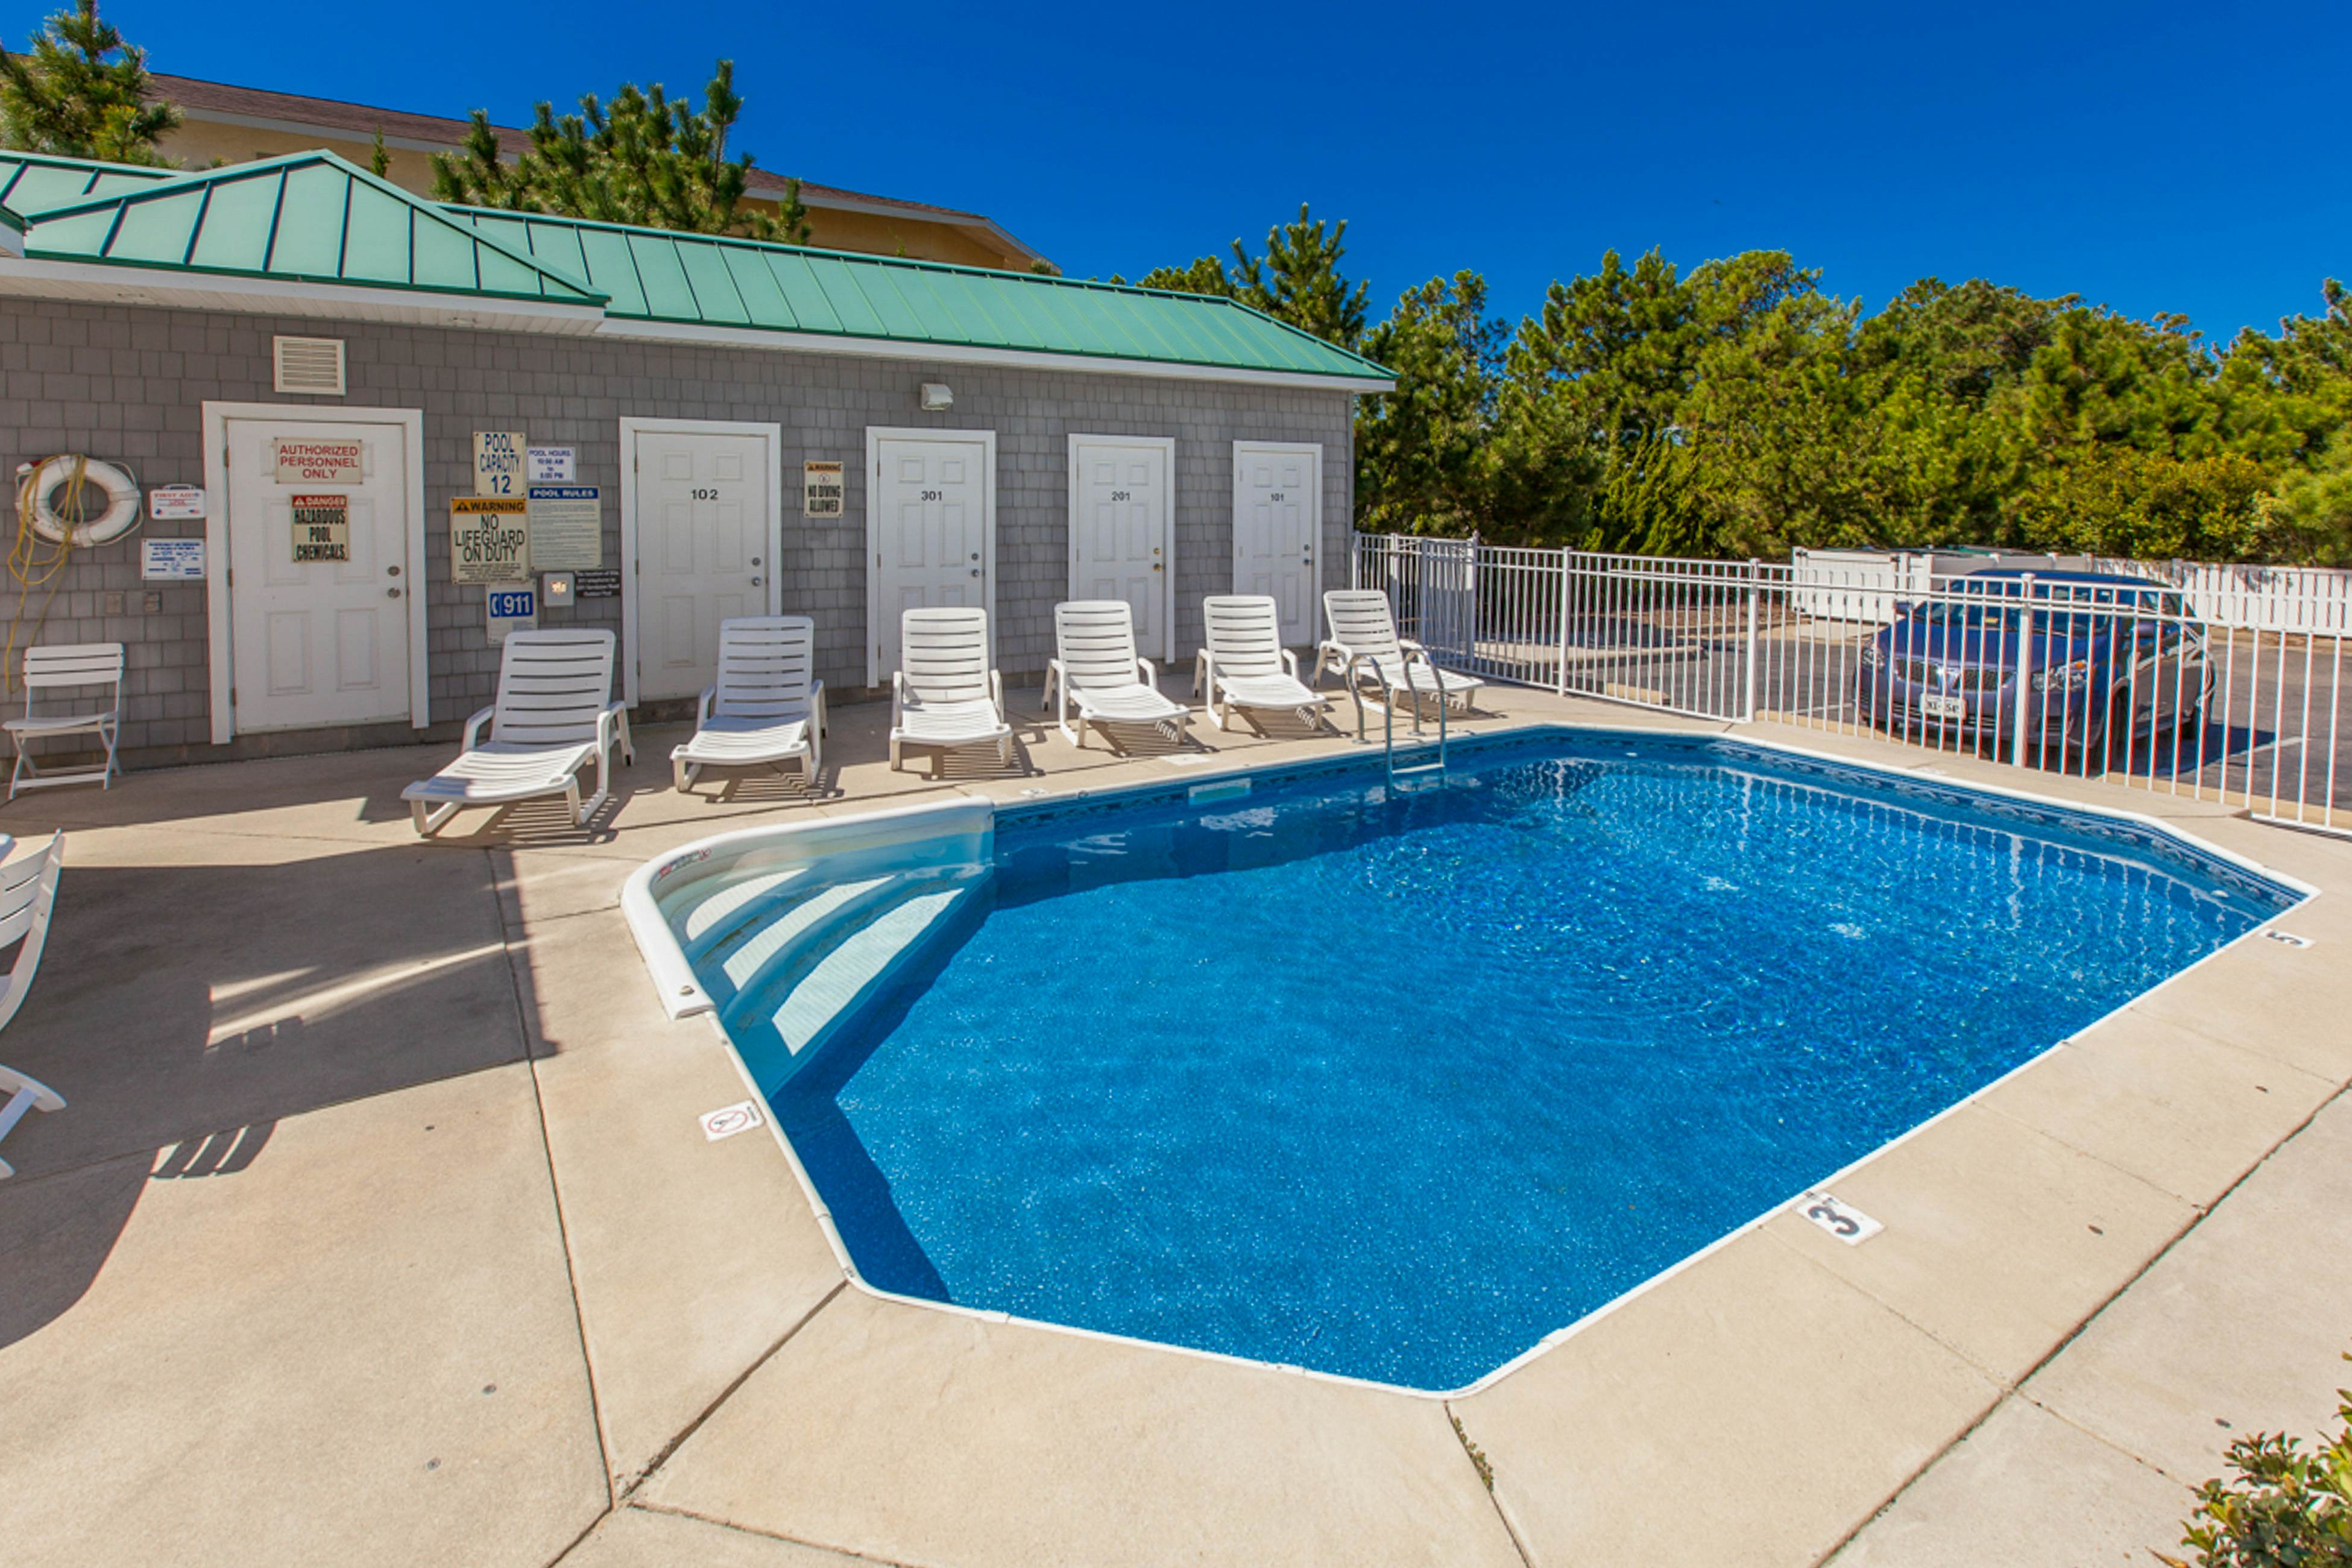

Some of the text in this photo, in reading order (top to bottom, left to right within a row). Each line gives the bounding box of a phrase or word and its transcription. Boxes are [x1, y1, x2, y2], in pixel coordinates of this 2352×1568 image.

[485, 433, 514, 453] POOL
[280, 444, 358, 456] AUTHORIZED
[280, 456, 358, 468] PERSONNEL
[480, 453, 521, 473] CAPACITY
[302, 468, 338, 479] ONLY
[491, 474, 511, 494] 12
[533, 489, 594, 497] POOL RULES
[691, 489, 719, 500] 102
[809, 485, 840, 498] NO DIVING
[921, 491, 942, 501] 301
[1111, 491, 1130, 501] 201
[1271, 493, 1284, 502] 101
[306, 496, 346, 506] DANGER
[470, 502, 524, 511] WARNING
[810, 499, 839, 512] ALLOWED
[294, 508, 345, 524] HAZARDOUS
[481, 513, 500, 530] NO
[309, 526, 332, 543] POOL
[454, 529, 525, 547] LIFEGUARD
[296, 544, 344, 560] CHEMICALS
[463, 545, 517, 562] ON DUTY
[503, 594, 530, 614] 911
[1808, 1206, 1861, 1236] 3
